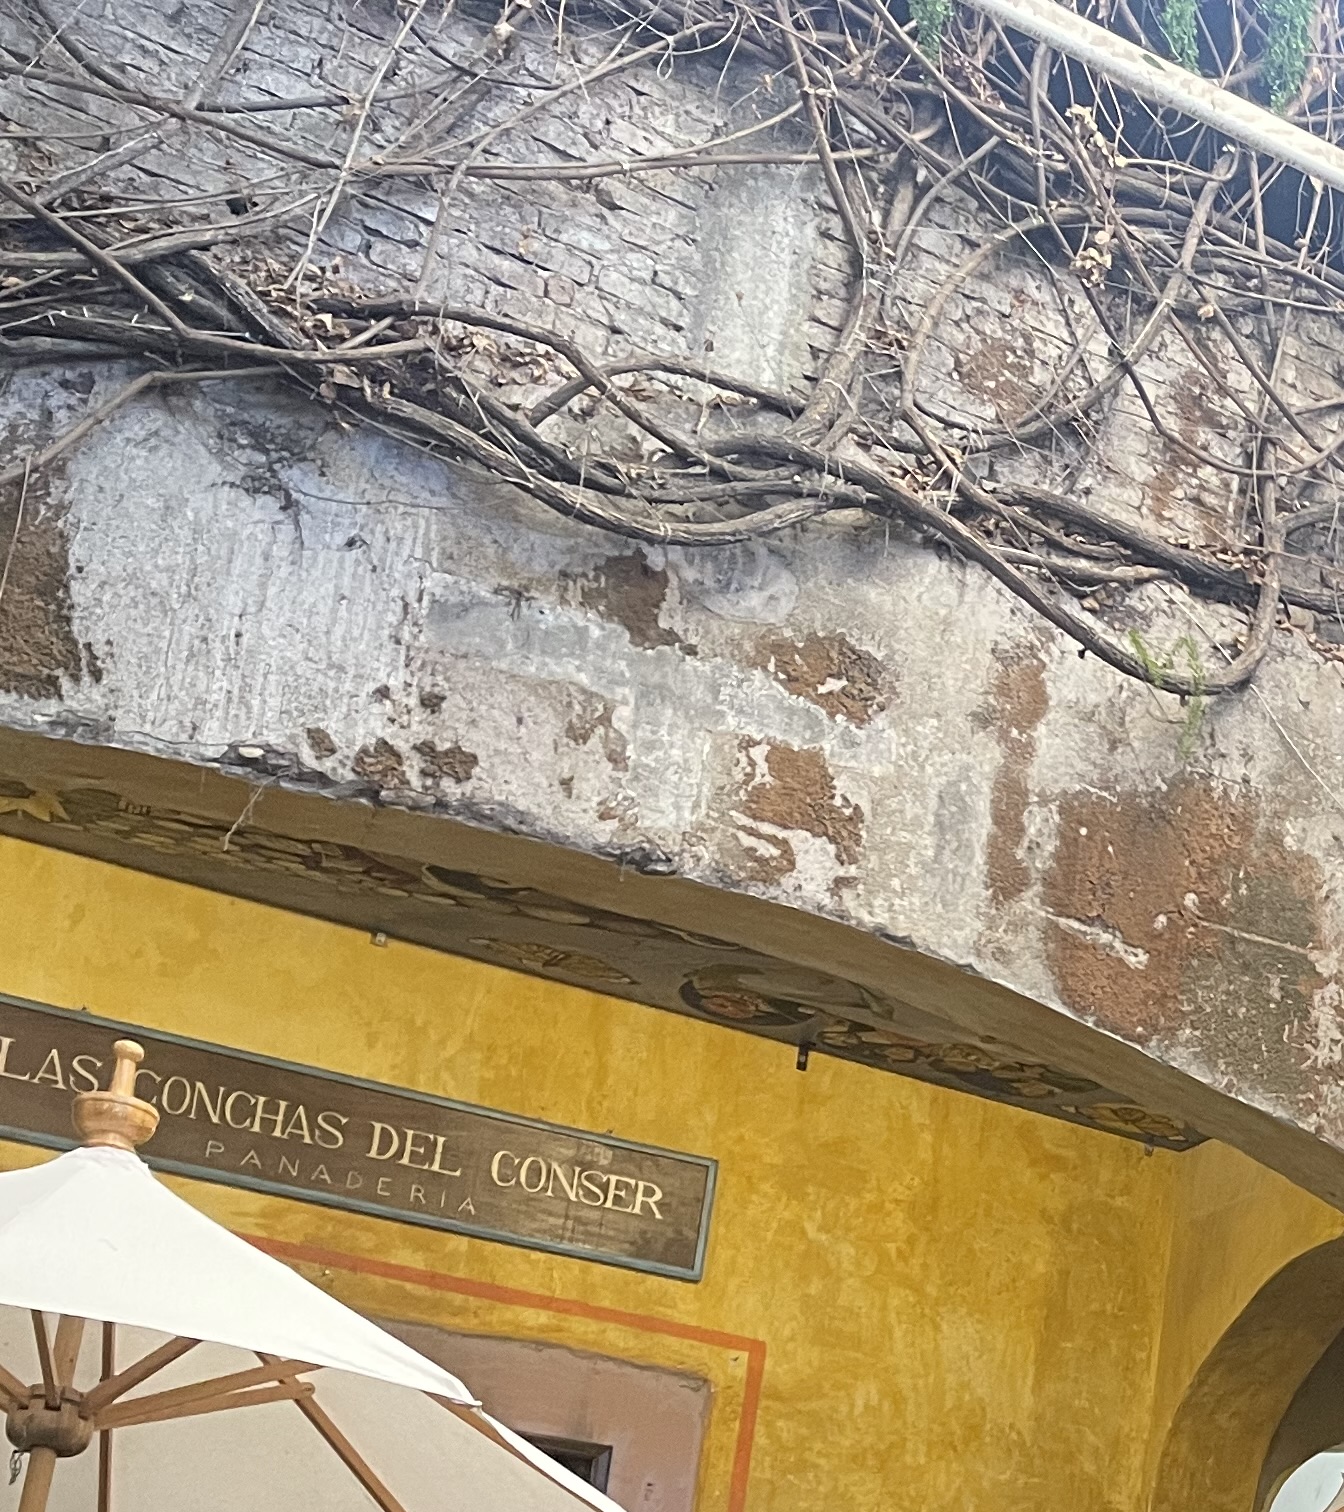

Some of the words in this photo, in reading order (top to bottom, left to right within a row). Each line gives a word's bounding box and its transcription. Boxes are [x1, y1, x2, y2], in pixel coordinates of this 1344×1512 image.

[0, 1036, 102, 1093] LAS
[366, 1121, 462, 1177] DEL
[491, 1150, 664, 1219] CONSER
[205, 1140, 476, 1216] PANADERIA
